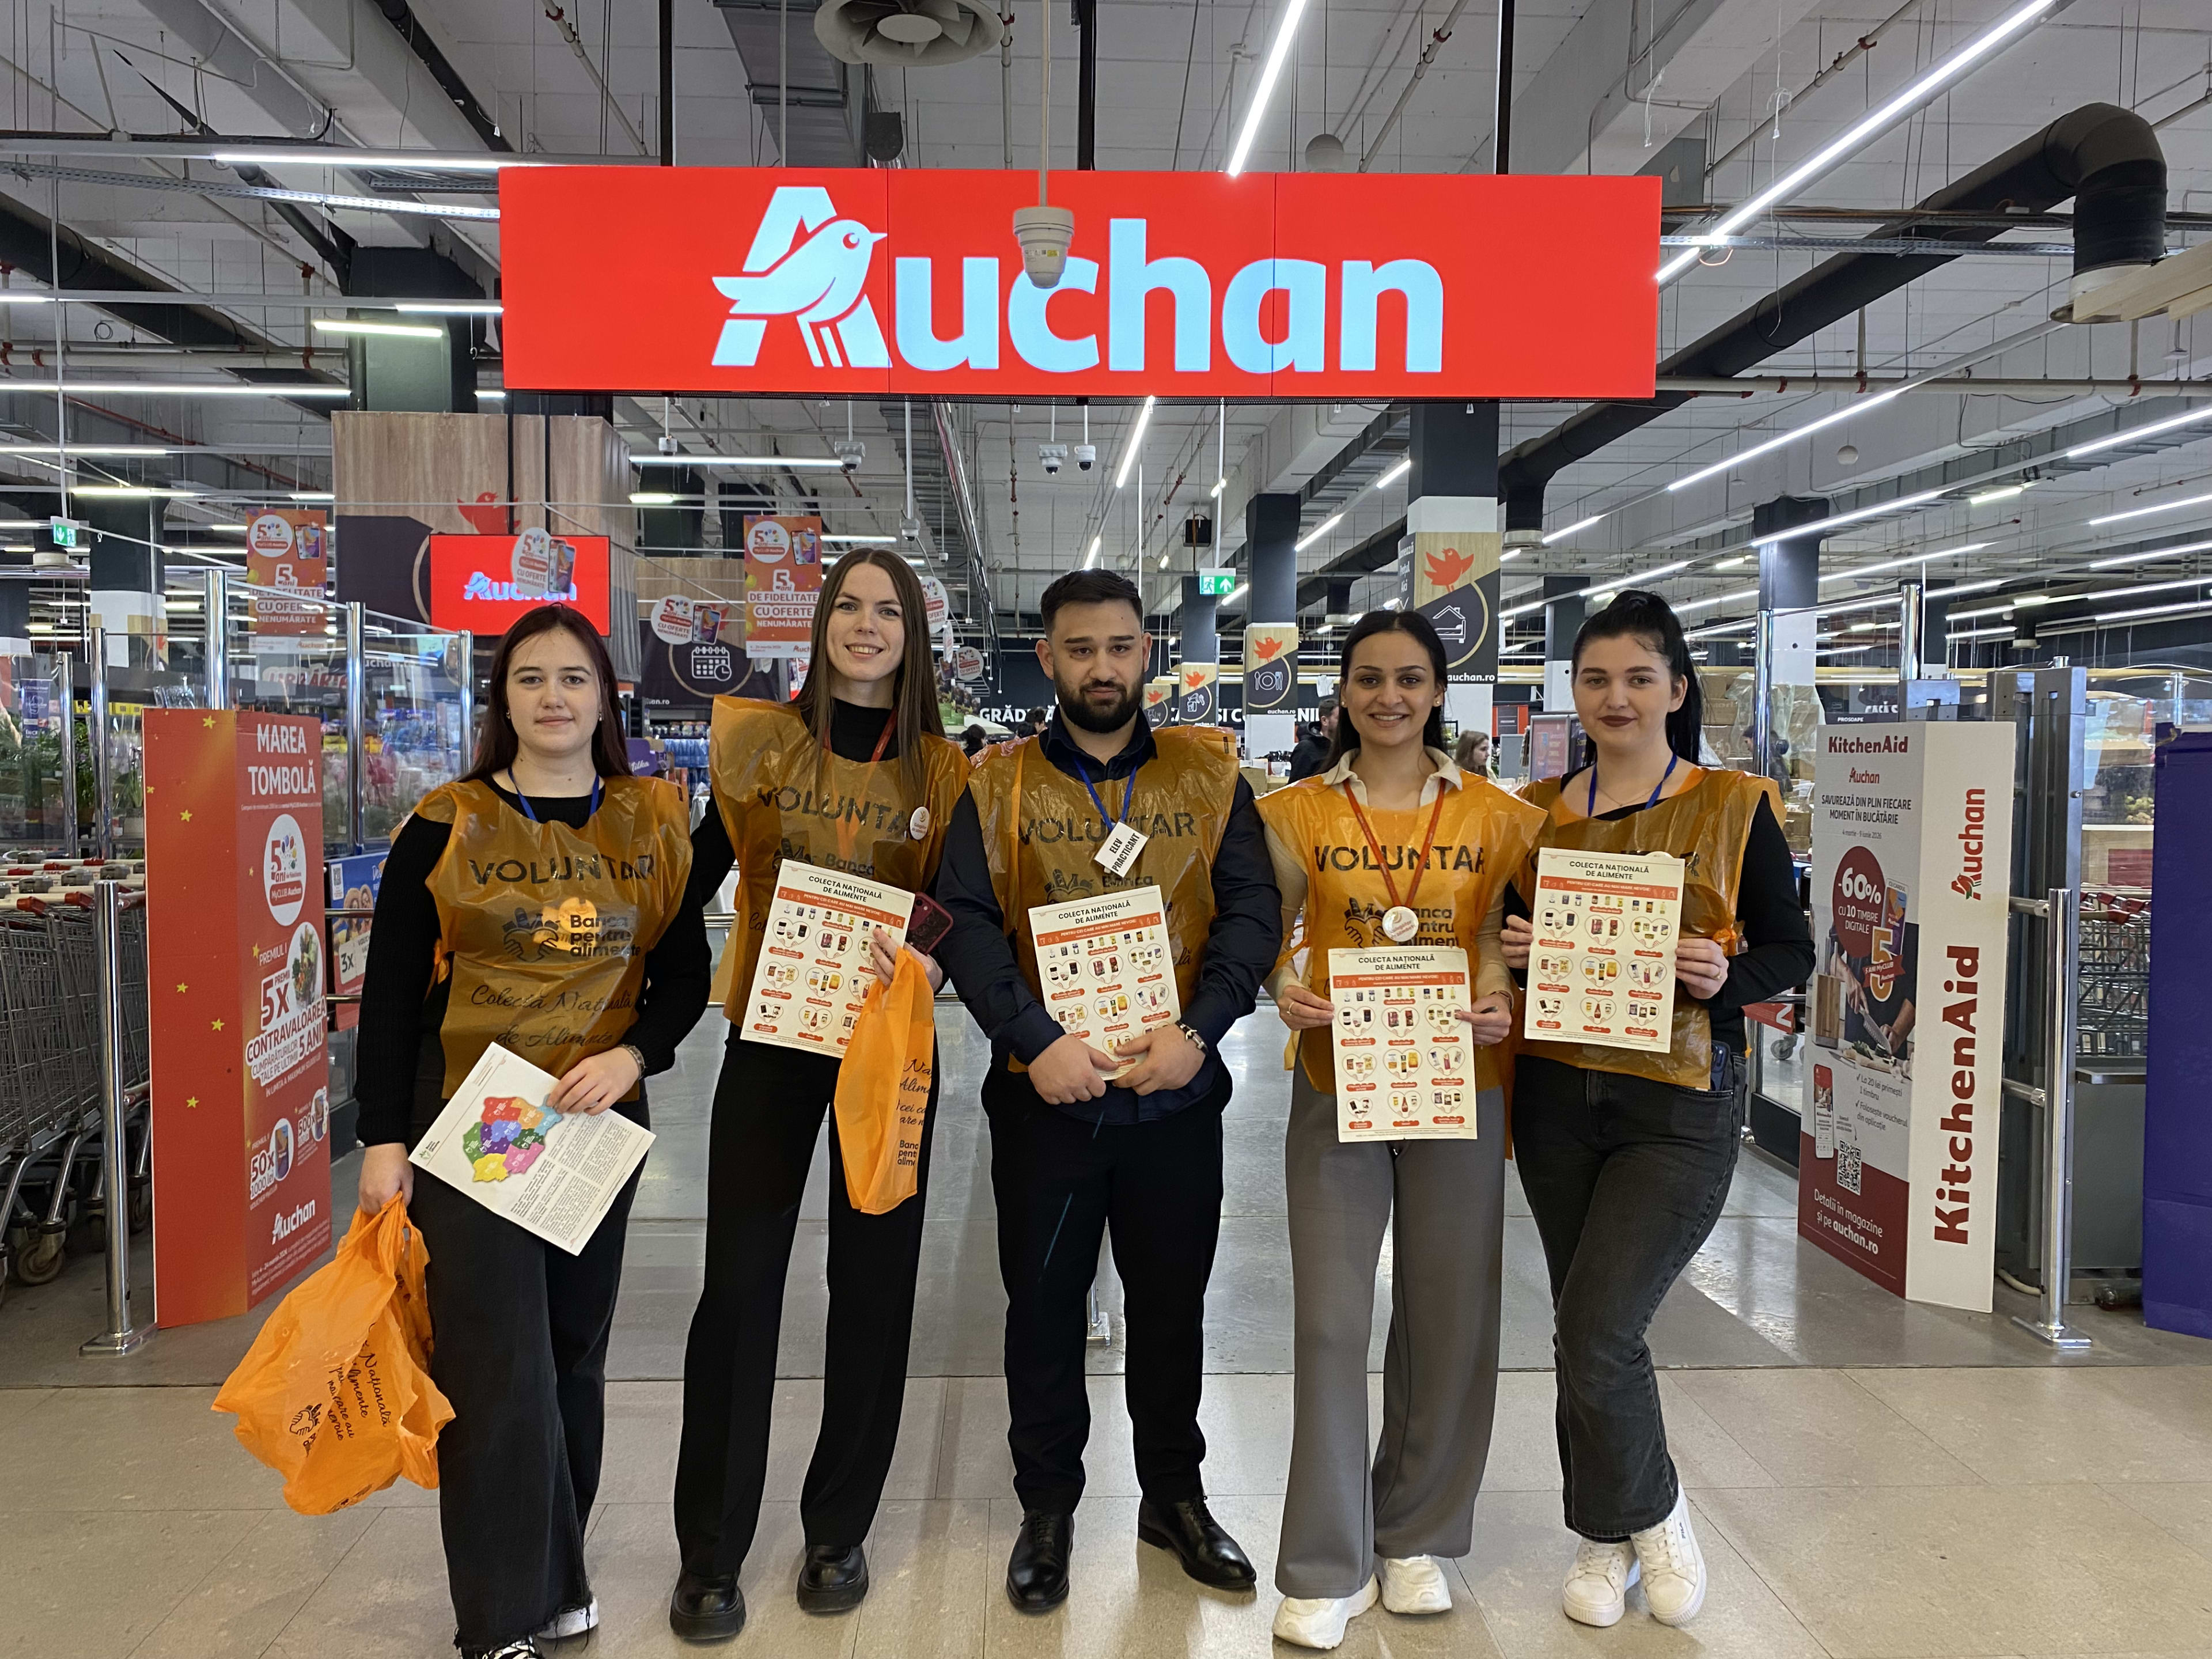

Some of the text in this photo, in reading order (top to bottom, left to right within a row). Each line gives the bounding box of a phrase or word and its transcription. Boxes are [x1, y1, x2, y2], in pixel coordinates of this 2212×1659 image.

[711, 186, 1443, 374] Auchan
[777, 573, 787, 589] 5
[750, 593, 818, 602] DE FIDELITATE
[257, 601, 318, 612] CU OFER
[756, 607, 813, 616] CU OFERTE
[259, 614, 316, 623] NENUMĂRATE
[757, 619, 812, 628] NENUMĂRATE
[667, 624, 690, 634] OFERTE
[793, 645, 810, 653] Auch
[1447, 672, 1495, 681] auchan.ro
[979, 704, 1056, 723] GRĂDĂ
[257, 724, 307, 754] MAREA
[1828, 736, 1908, 753] KitchenAid
[248, 759, 316, 796] TOMBOLĂ
[1849, 767, 1880, 784] Auchan
[757, 786, 910, 834] VOLUNTA
[1821, 794, 1912, 810] SAVUREAZĂ DIN PLIN FIECARE
[1830, 808, 1899, 824] MOMENT ÎN BUCĂTĂRIE
[1018, 812, 1197, 845] VOLUTAR
[1109, 837, 1123, 854] ELEV
[1111, 832, 1141, 872] PRACTICANT
[1951, 789, 1986, 901] Auchan
[275, 868, 286, 883] ani
[469, 853, 657, 885] VOLUNTAR
[1570, 861, 1649, 873] COLECTA NAȚIONALĂ
[1596, 872, 1633, 880] ALIMENTE
[271, 885, 302, 900] MyCLUB Auchan
[809, 876, 882, 900] COLECTA NAȚIONALĂ
[1838, 867, 1882, 904] -60%
[833, 888, 867, 903] ALIMENTE
[1058, 900, 1131, 919] COLECTA NAȚIONALĂ
[1085, 911, 1118, 923] ALIMENTE
[1415, 907, 1453, 919] anca
[1838, 904, 1878, 922] CU 10 TIMBRE
[570, 915, 628, 928] Banca
[1419, 921, 1455, 933] ntru
[1845, 922, 1870, 934] DIGITALE
[259, 945, 285, 967] PREMIUL
[340, 952, 355, 974] 3X
[1392, 953, 1435, 963] NAȚIONALĂ
[1871, 926, 1893, 1002] 5
[1876, 961, 1894, 972] MyCLUB
[263, 979, 289, 1027] 5X
[247, 998, 326, 1063] CONTRAVALOAREA
[495, 1025, 520, 1047] de
[252, 1039, 298, 1076] CUMPĂRĂTURILOR
[299, 1034, 306, 1059] 5
[307, 1021, 322, 1052] ANI
[260, 1066, 272, 1084] TALE
[274, 1062, 281, 1075] PE
[281, 1051, 298, 1071] ULTIMII
[900, 1077, 930, 1094] Alim
[1861, 1076, 1867, 1084] La
[1868, 1077, 1874, 1086] 20
[1882, 1081, 1903, 1097] primești
[1863, 1087, 1879, 1101] timbru
[1934, 945, 1979, 1245] KitchenAid
[900, 1104, 915, 1112] cei
[298, 1113, 316, 1136] 500x
[900, 1116, 917, 1125] are
[1857, 1113, 1865, 1121] din
[900, 1139, 919, 1150] Banc
[897, 1157, 915, 1166] alim
[898, 1149, 916, 1158] pent
[251, 1151, 274, 1183] 50x
[251, 1176, 266, 1198] 1000
[1815, 1188, 1883, 1237] Detalii în magazine
[272, 1200, 315, 1245] Auchan
[1817, 1210, 1878, 1255] și pe auchan.ro
[347, 1368, 369, 1418] limente
[358, 1353, 391, 1427] Națională
[346, 1422, 355, 1438] au
